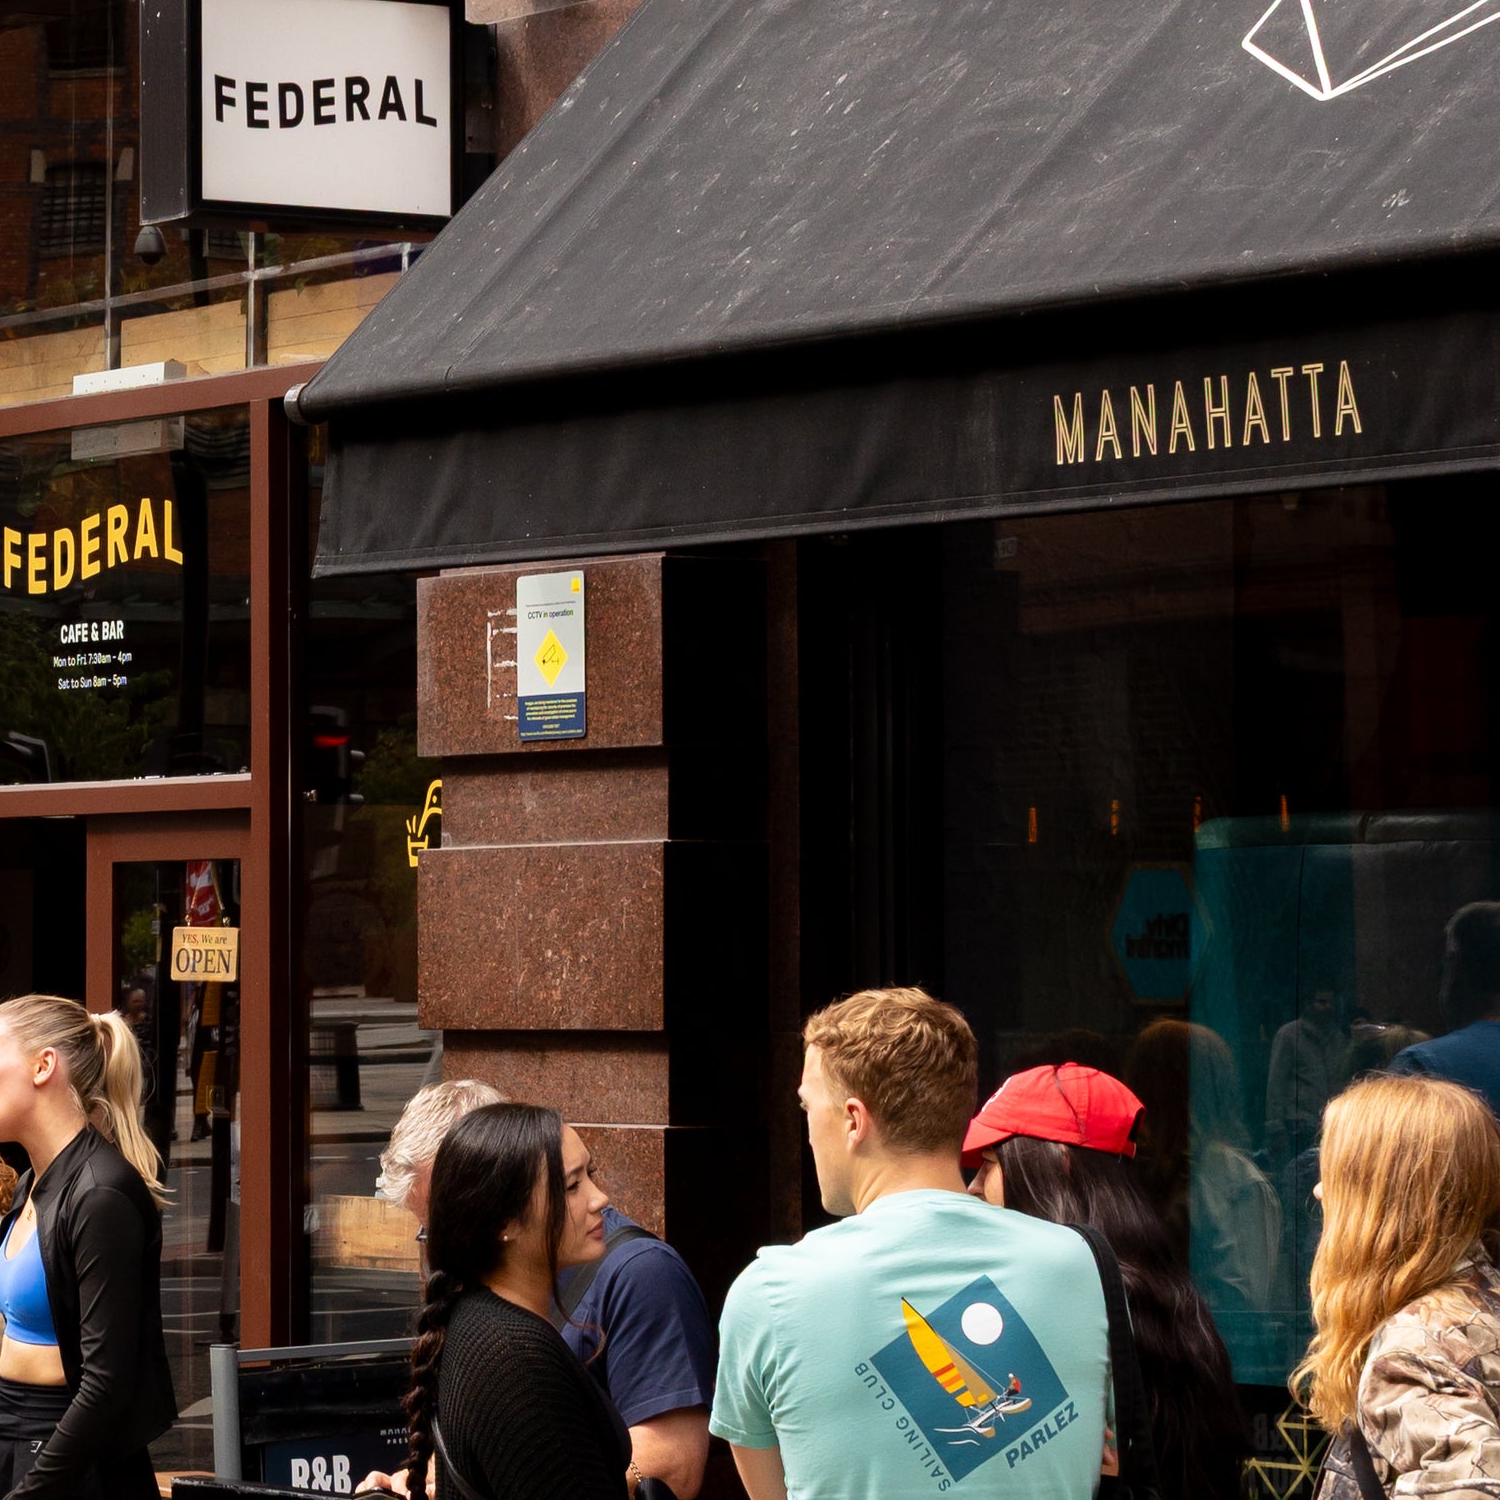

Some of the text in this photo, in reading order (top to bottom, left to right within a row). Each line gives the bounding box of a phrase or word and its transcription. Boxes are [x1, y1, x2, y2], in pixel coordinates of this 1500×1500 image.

[214, 74, 437, 129] FEDERAL
[1054, 360, 1362, 465] MANAHATTA
[4, 498, 183, 594] FEDERAL
[527, 609, 574, 620] CCTV in operation
[60, 620, 124, 644] CAFE & BAR
[53, 656, 67, 668] Mon
[68, 656, 76, 666] to
[76, 654, 87, 666] Fri
[88, 652, 111, 665] 7:30am
[117, 651, 132, 665] 4pm
[58, 678, 70, 690] Sat
[70, 678, 79, 689] to
[80, 676, 92, 688] Sun
[93, 675, 107, 687] 8am
[112, 674, 127, 688] 5pm
[182, 933, 228, 945] YES, We are
[176, 948, 232, 974] OPEN
[854, 1362, 951, 1492] SAILING CLUB
[1005, 1402, 1079, 1469] PARLEZ
[291, 1454, 352, 1494] R&B
